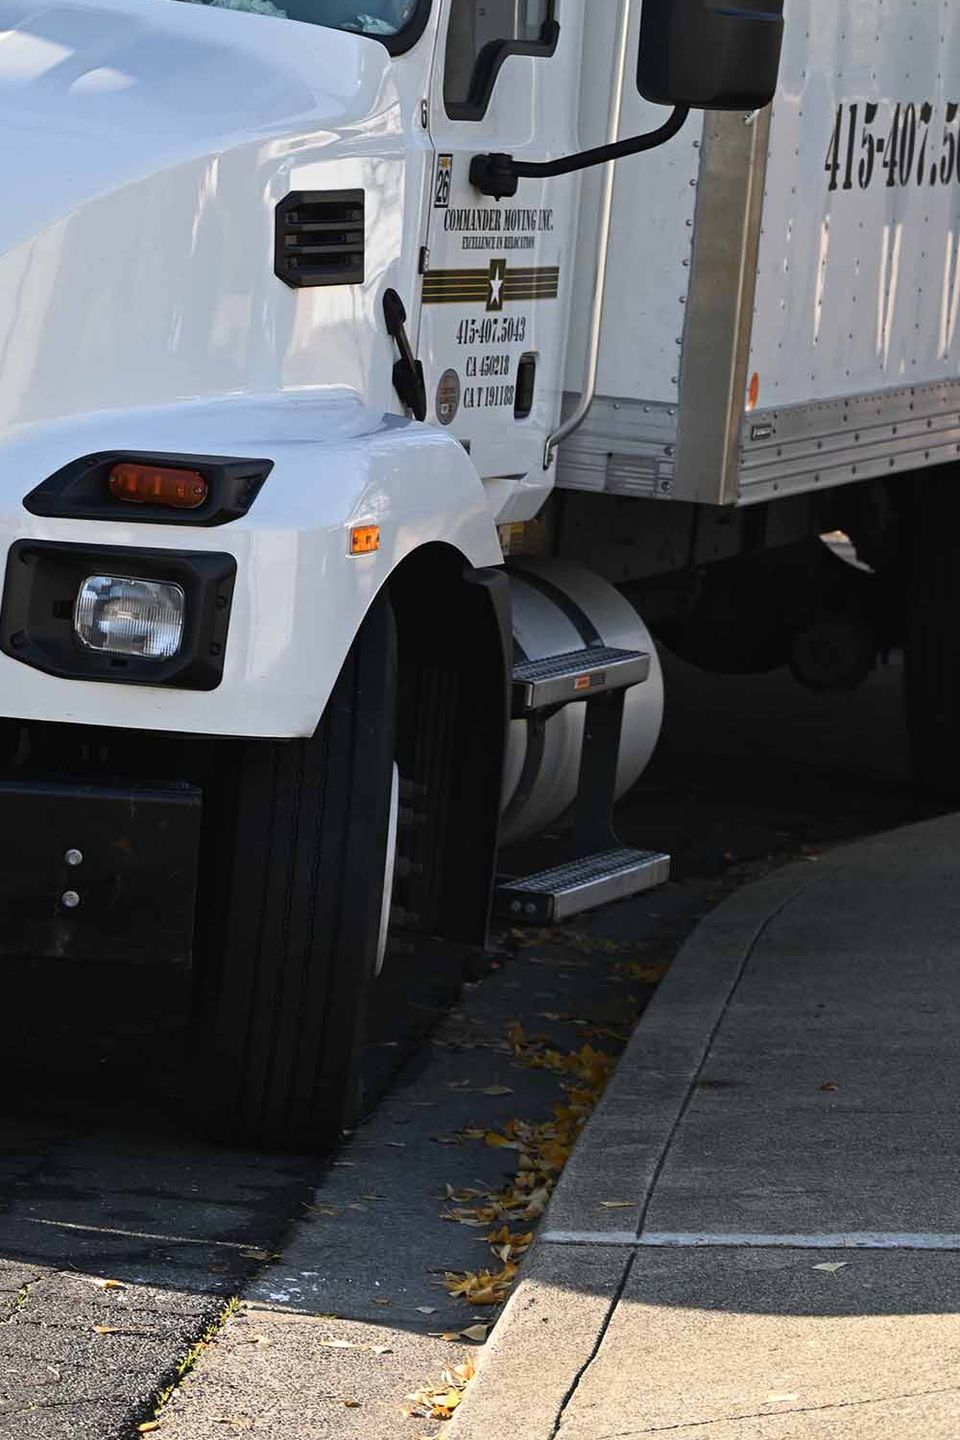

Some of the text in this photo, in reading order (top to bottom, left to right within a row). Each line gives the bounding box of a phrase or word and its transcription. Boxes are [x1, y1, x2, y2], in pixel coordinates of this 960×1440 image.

[824, 102, 960, 191] 415-407.5
[436, 170, 449, 202] 26
[444, 209, 553, 232] COMMANDER MOVING INC.
[462, 236, 495, 249] EXCELLENCE
[496, 236, 503, 249] IN
[456, 316, 526, 344] 415-407.5043
[466, 356, 477, 377] CA
[463, 387, 474, 408] CA
[485, 385, 515, 407] 191188
